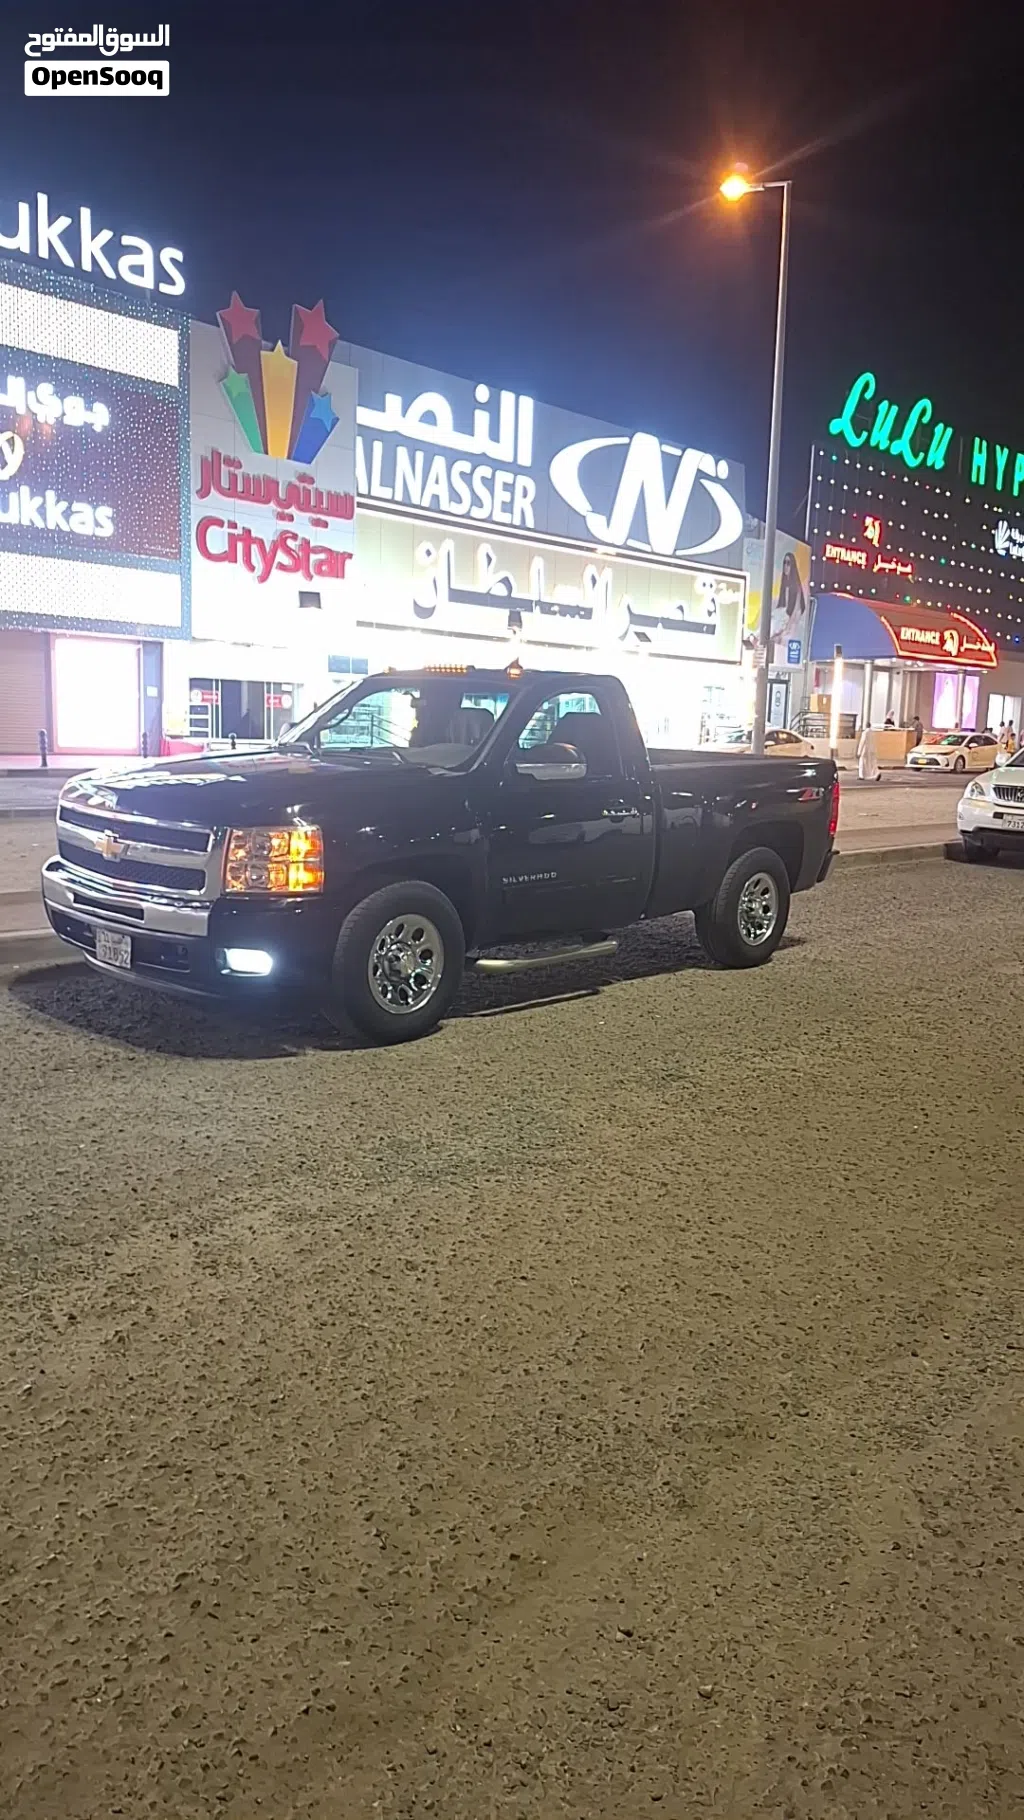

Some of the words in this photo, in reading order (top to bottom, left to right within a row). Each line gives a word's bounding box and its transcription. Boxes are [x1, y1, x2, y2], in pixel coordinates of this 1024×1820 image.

[356, 383, 534, 468] النص
[829, 372, 953, 470] LuLu
[971, 436, 1024, 497] HYP
[196, 515, 353, 584] CityStar
[825, 544, 867, 566] ENTRANCE
[901, 626, 940, 646] ENTRANCE
[502, 871, 557, 884] SILVERADO
